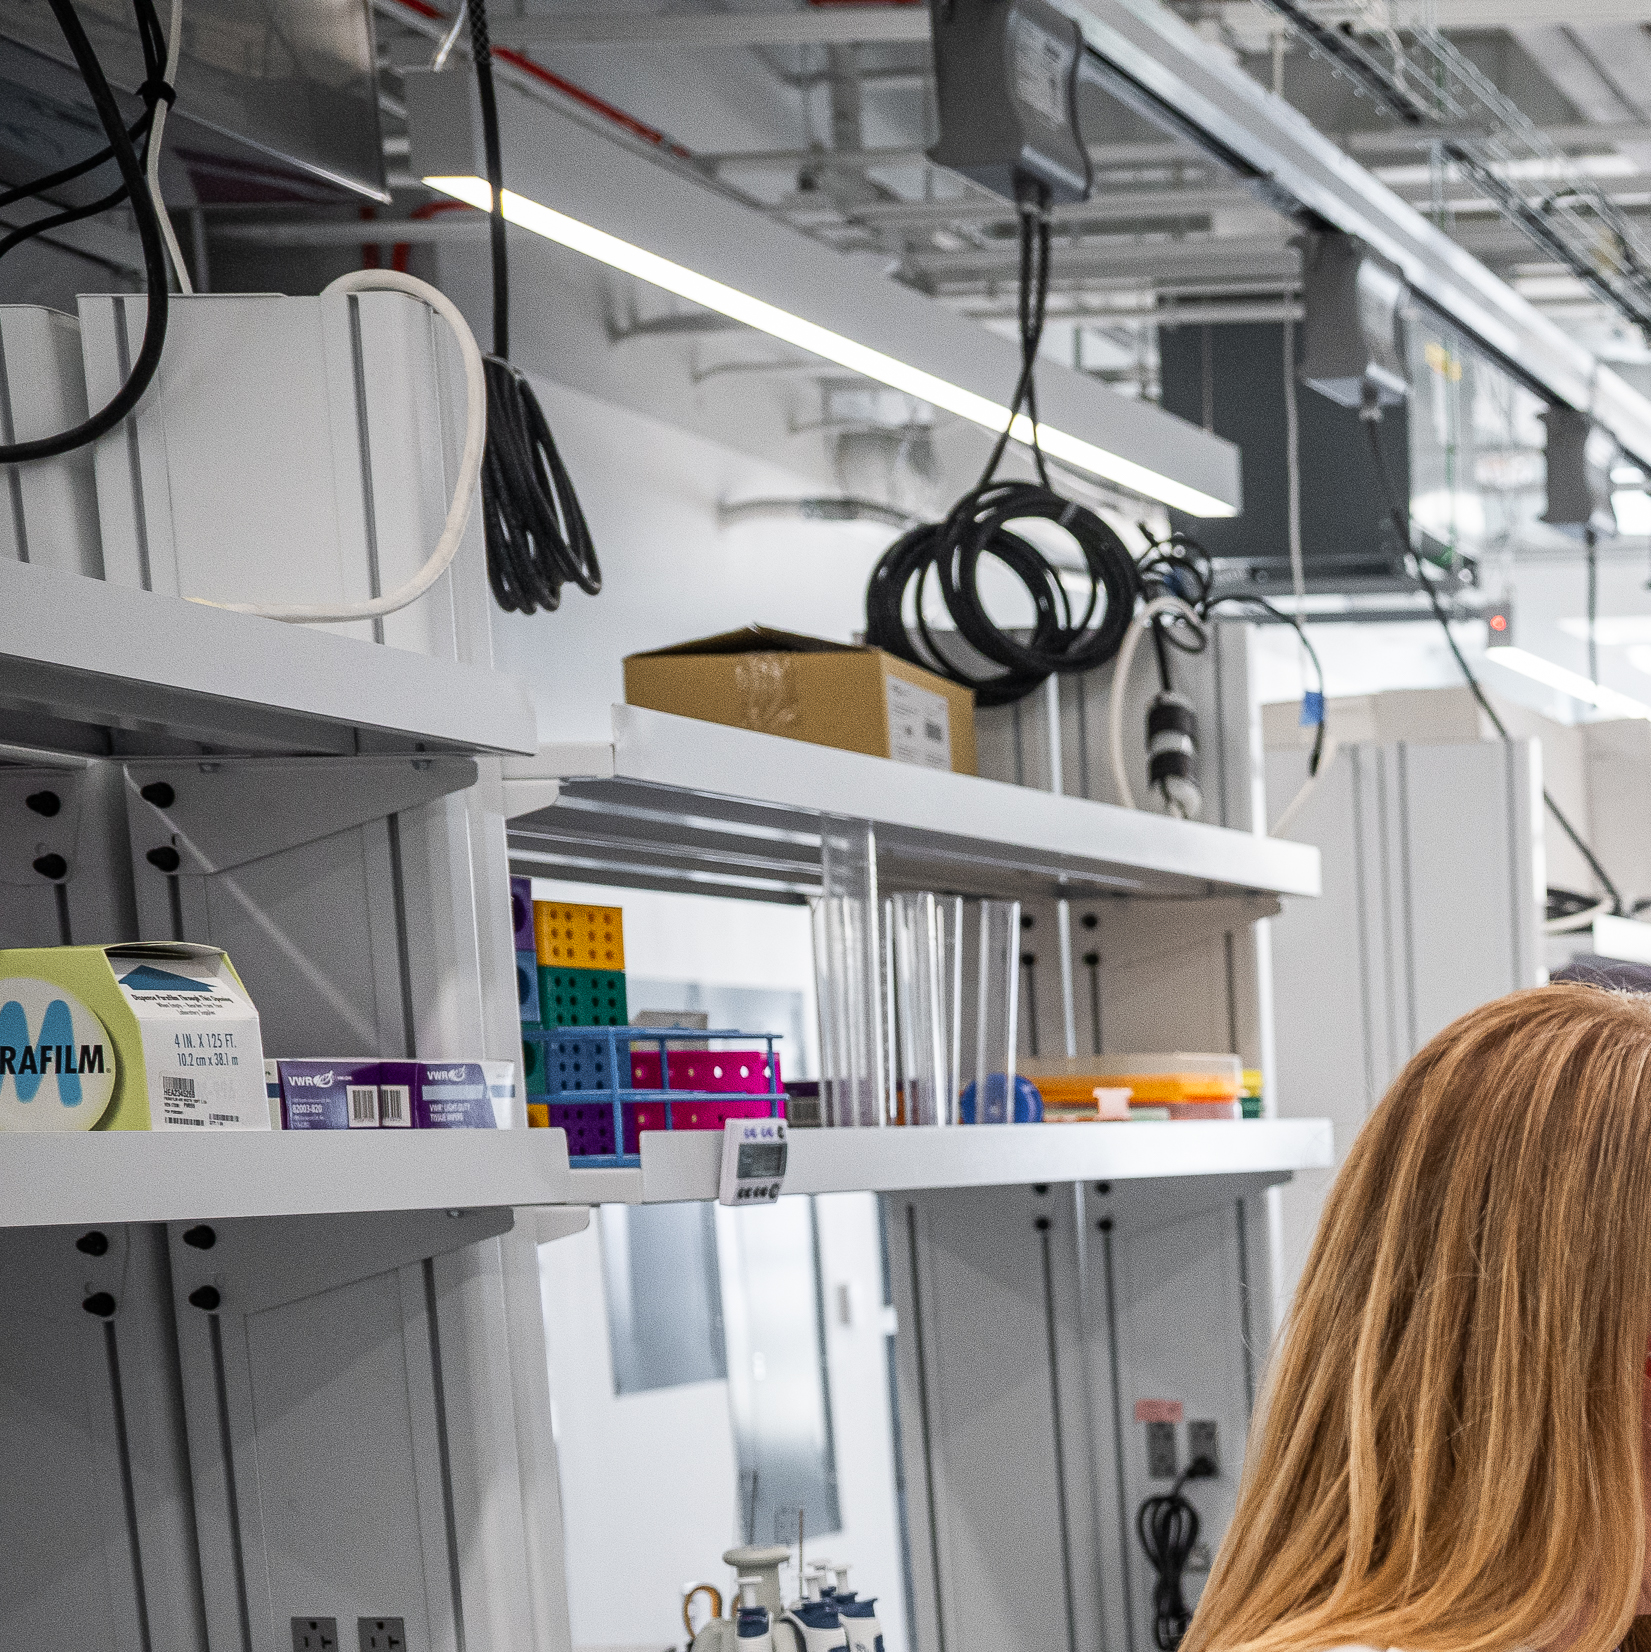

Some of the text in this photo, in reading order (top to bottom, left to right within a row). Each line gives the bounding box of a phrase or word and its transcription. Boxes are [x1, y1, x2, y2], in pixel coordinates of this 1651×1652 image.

[174, 1034, 181, 1049] 4
[183, 1034, 196, 1049] IN.
[208, 1033, 223, 1048] 125
[226, 1034, 237, 1048] FT.
[177, 1053, 194, 1067] 10.2
[196, 1056, 207, 1066] cm
[214, 1053, 229, 1067] 38.1
[231, 1056, 239, 1066] m
[288, 1076, 314, 1086] VWR
[427, 1070, 448, 1080] VWR
